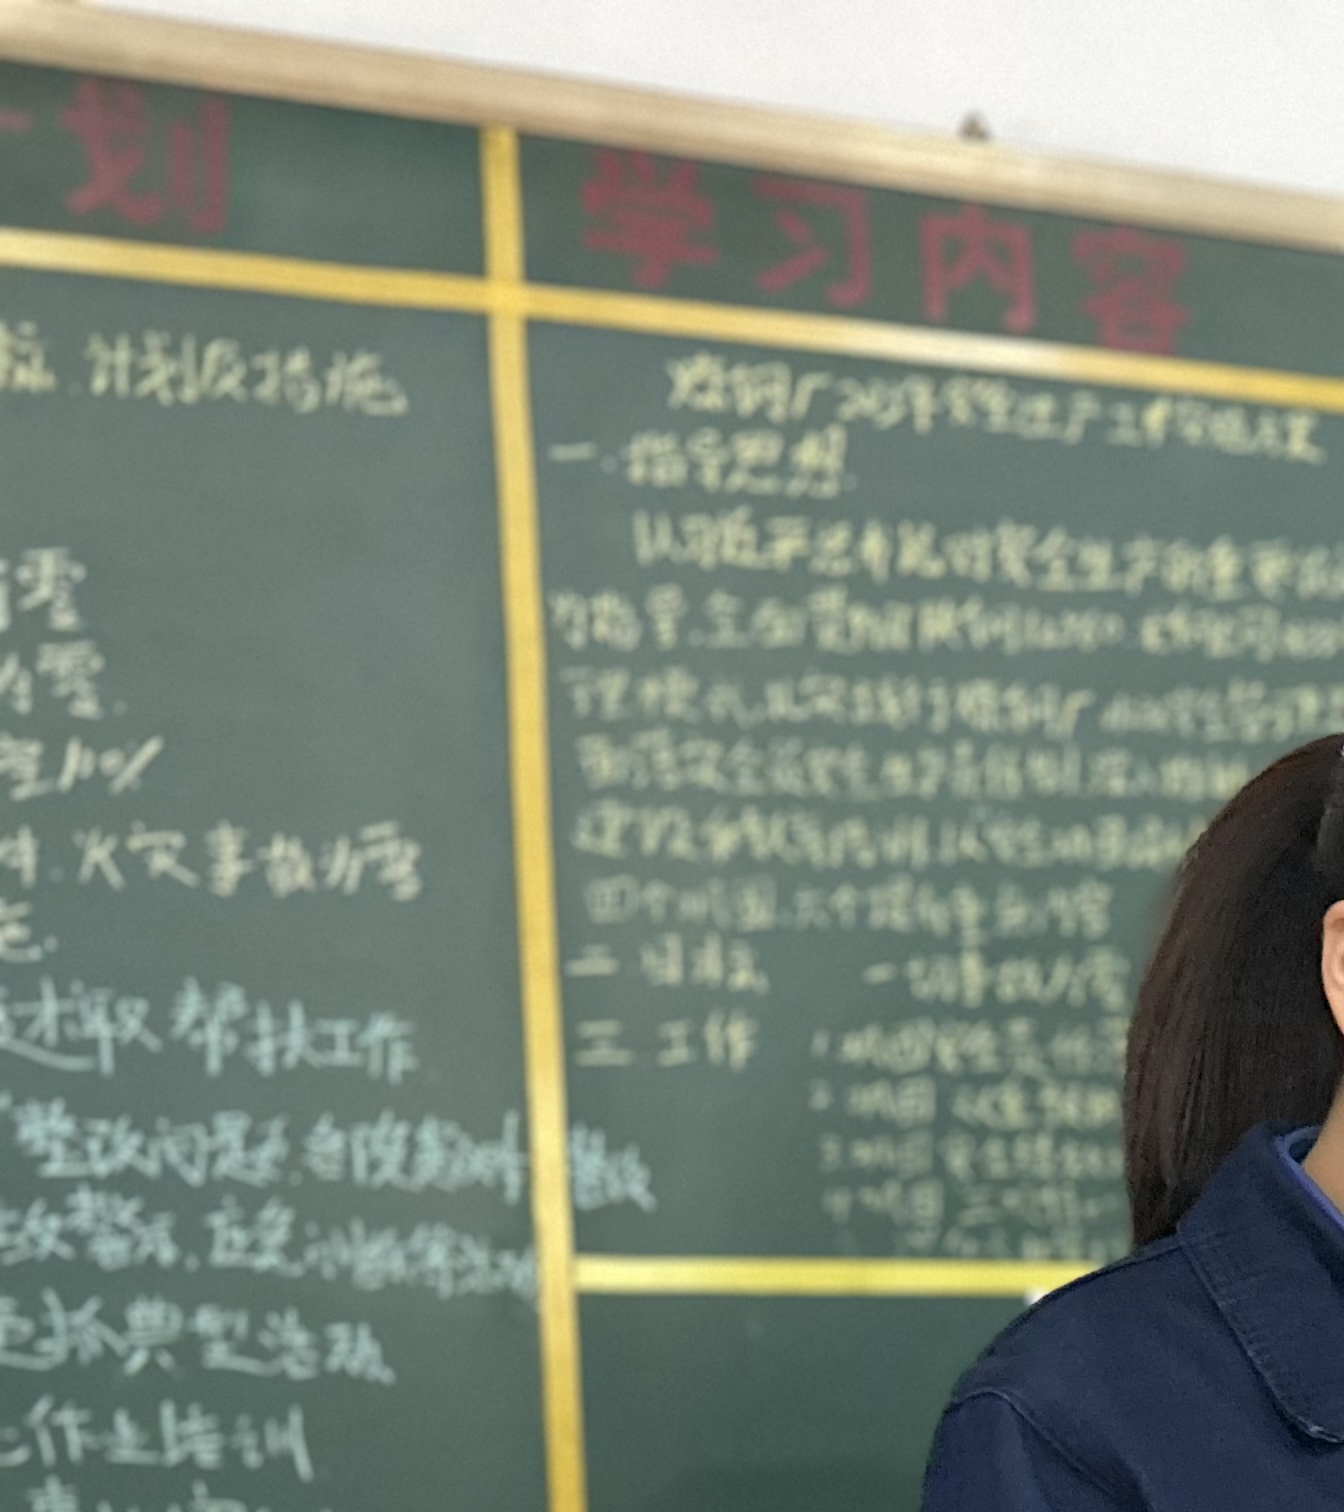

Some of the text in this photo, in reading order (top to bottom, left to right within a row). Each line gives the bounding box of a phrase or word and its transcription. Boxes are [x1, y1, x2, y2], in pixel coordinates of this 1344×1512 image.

[0, 76, 232, 236] 划
[582, 148, 1190, 354] 学习内容
